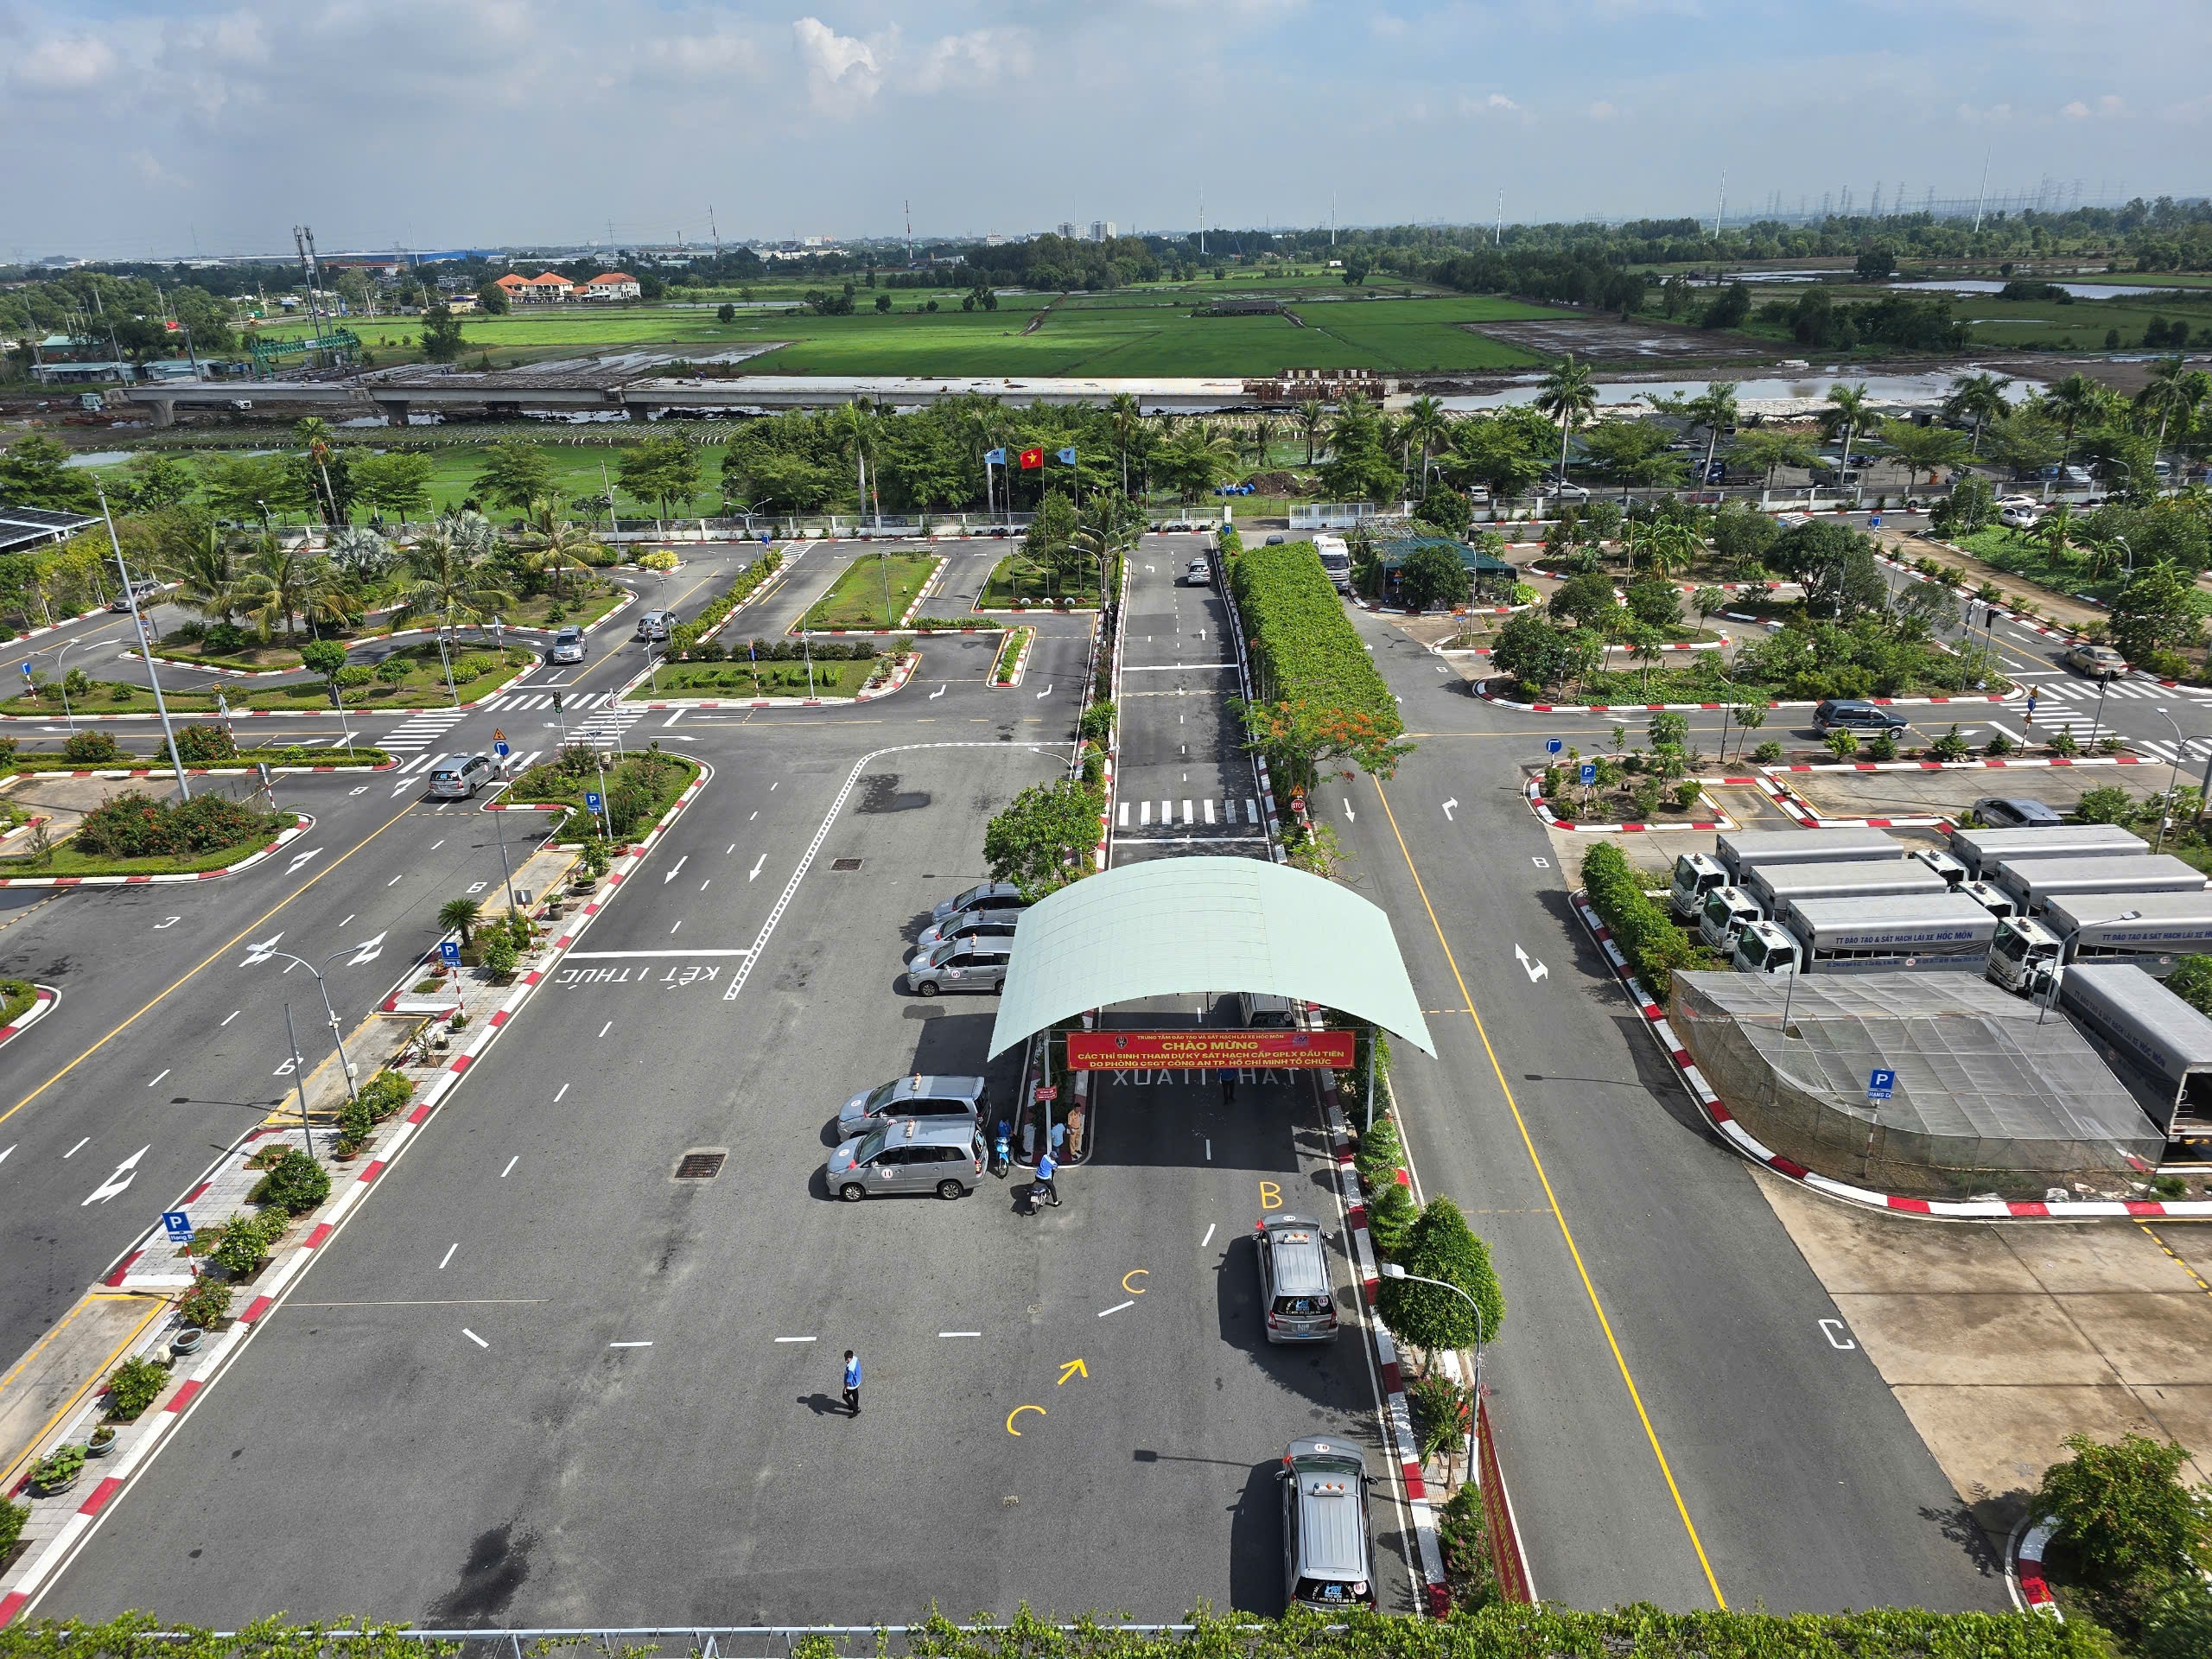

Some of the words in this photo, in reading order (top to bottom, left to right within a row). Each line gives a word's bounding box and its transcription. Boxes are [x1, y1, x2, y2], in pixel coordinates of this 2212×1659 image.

[444, 945, 454, 956] P
[1162, 1040, 1208, 1051] CHÀO
[1211, 1039, 1258, 1049] MỪNG
[1876, 1073, 1889, 1085] P
[1260, 1181, 1282, 1208] B
[169, 1217, 181, 1229] P
[1122, 1269, 1150, 1294] C
[1818, 1319, 1856, 1350] C
[1006, 1405, 1047, 1436] C
